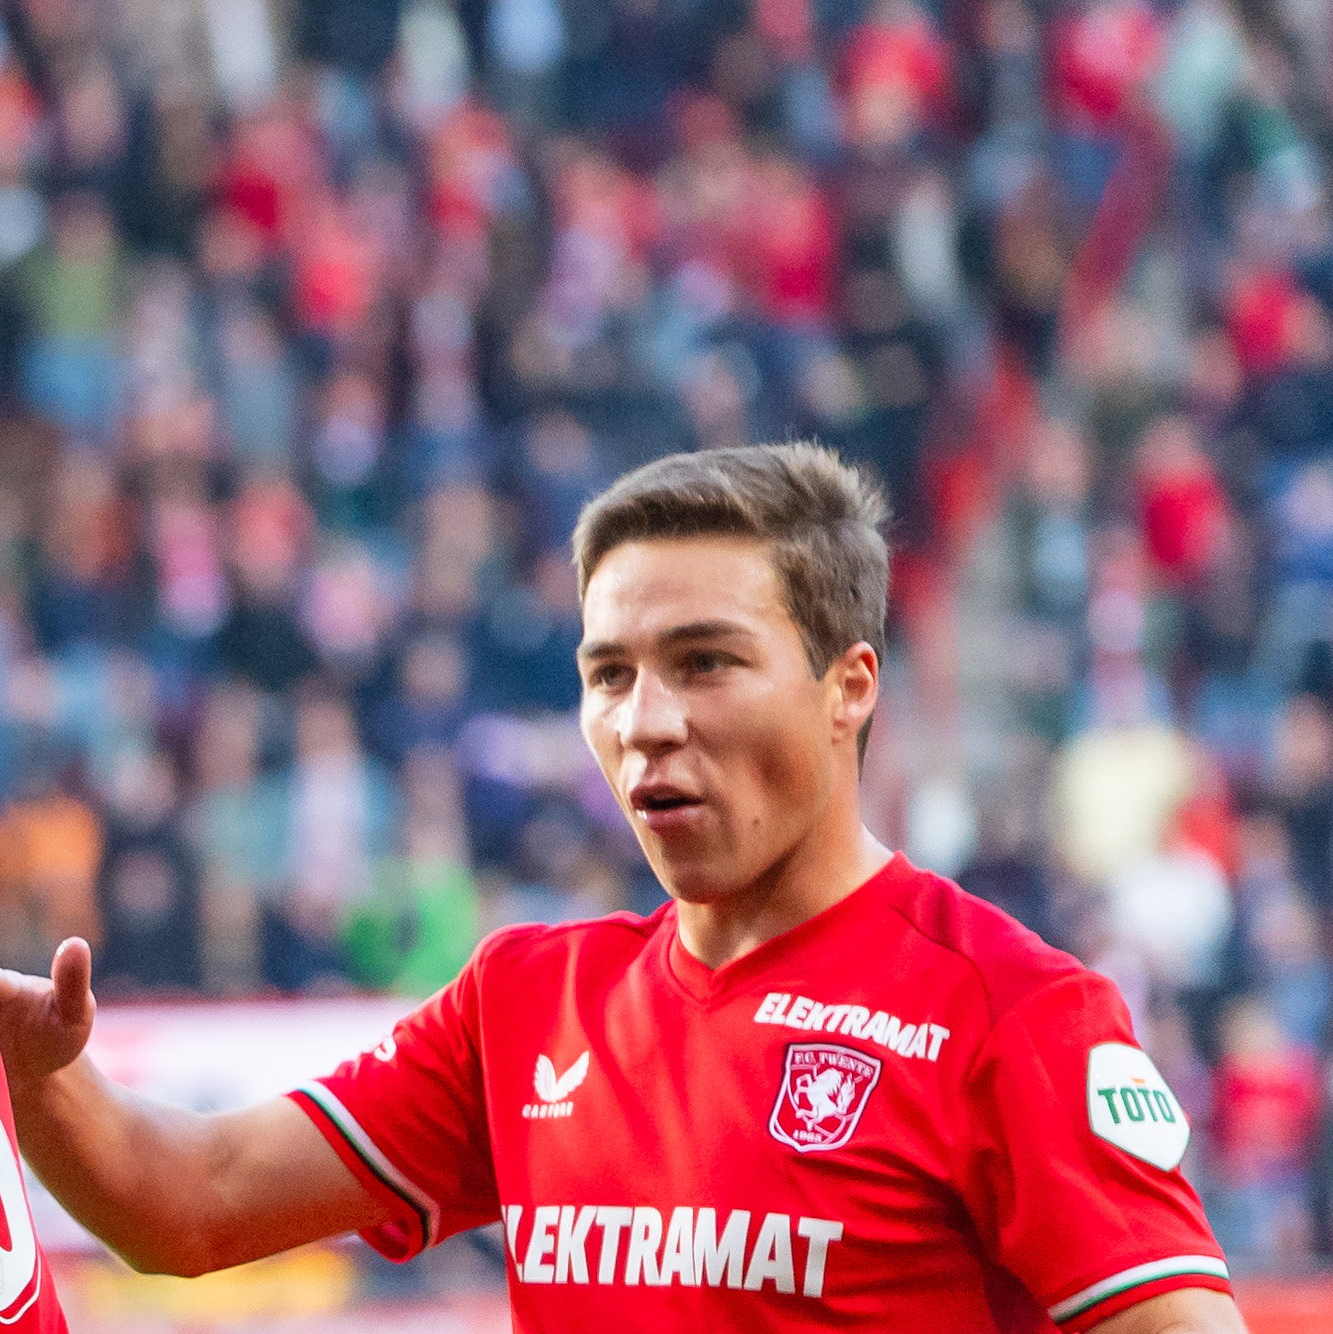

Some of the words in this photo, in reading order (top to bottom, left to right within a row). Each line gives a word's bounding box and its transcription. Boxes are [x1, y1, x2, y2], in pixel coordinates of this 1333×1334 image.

[754, 993, 950, 1062] ELEKTRAMAT
[1098, 1088, 1176, 1124] TOTO
[502, 1204, 844, 1298] LEKTRAMAT
